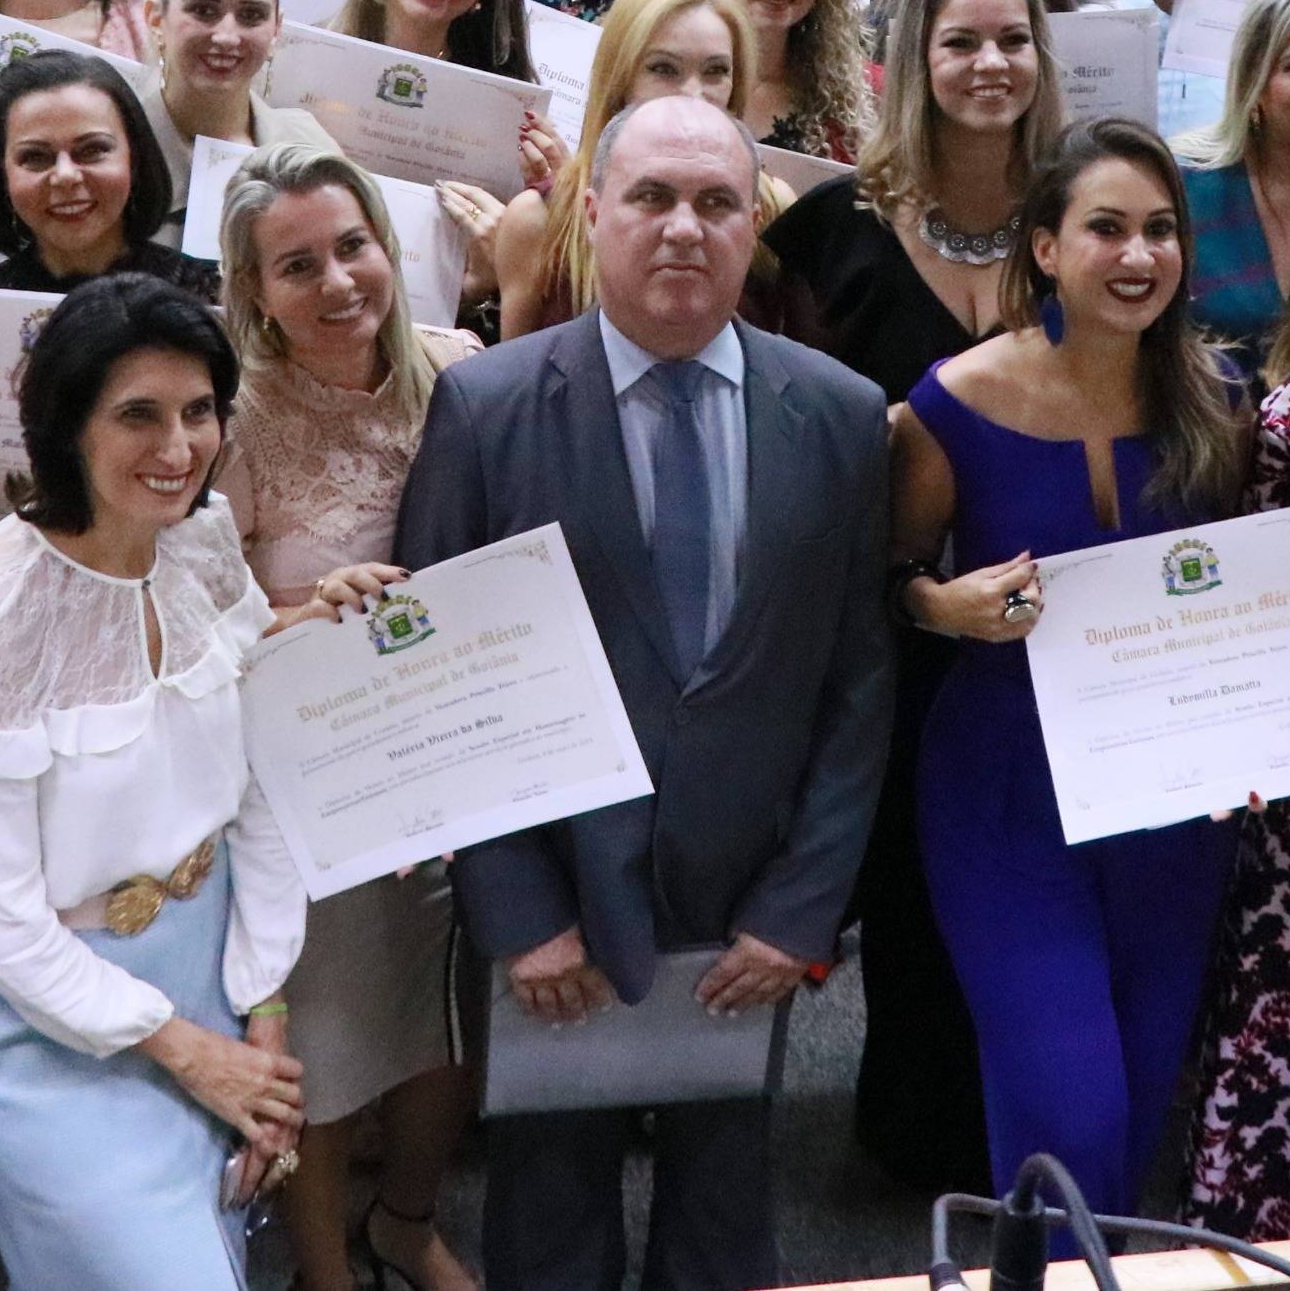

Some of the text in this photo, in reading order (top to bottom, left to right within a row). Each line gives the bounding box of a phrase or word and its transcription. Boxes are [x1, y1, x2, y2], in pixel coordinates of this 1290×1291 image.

[538, 63, 585, 90] Diploma
[1083, 623, 1152, 649] Diploma
[1155, 615, 1174, 633] de
[1177, 607, 1229, 629] Honra
[1234, 602, 1253, 617] ao
[1111, 645, 1161, 664] Câmara
[1163, 627, 1225, 654] Municipal
[1228, 625, 1242, 641] de
[297, 622, 534, 724] Diploma de Honra ao Mérito
[329, 652, 520, 733] Câmara Municipal de Goiânia
[461, 723, 474, 737] da
[474, 714, 504, 732] Silva
